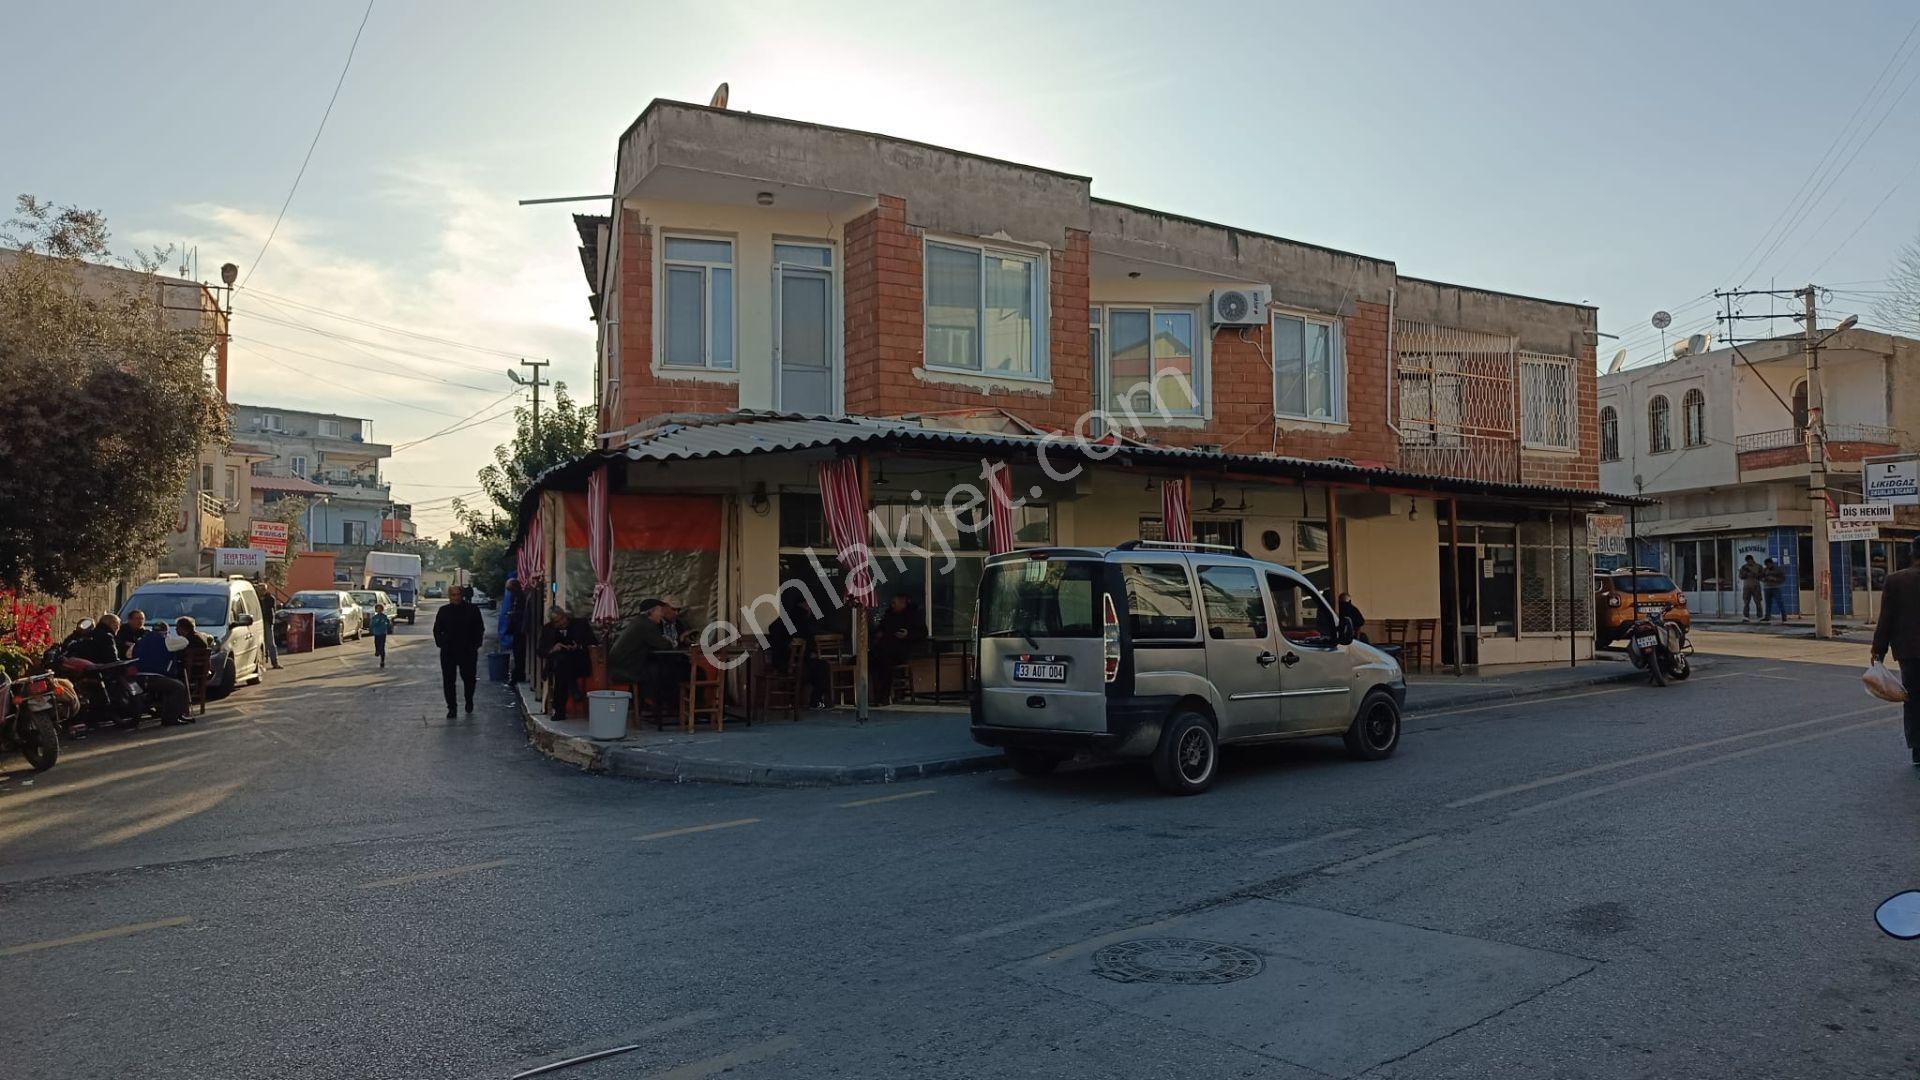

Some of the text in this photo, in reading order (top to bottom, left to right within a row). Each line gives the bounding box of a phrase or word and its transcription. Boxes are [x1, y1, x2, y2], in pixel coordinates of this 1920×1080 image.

[1843, 505, 1891, 517] DİŞ HEKİMİ
[1020, 665, 1029, 677] 33
[1048, 666, 1063, 679] 004
